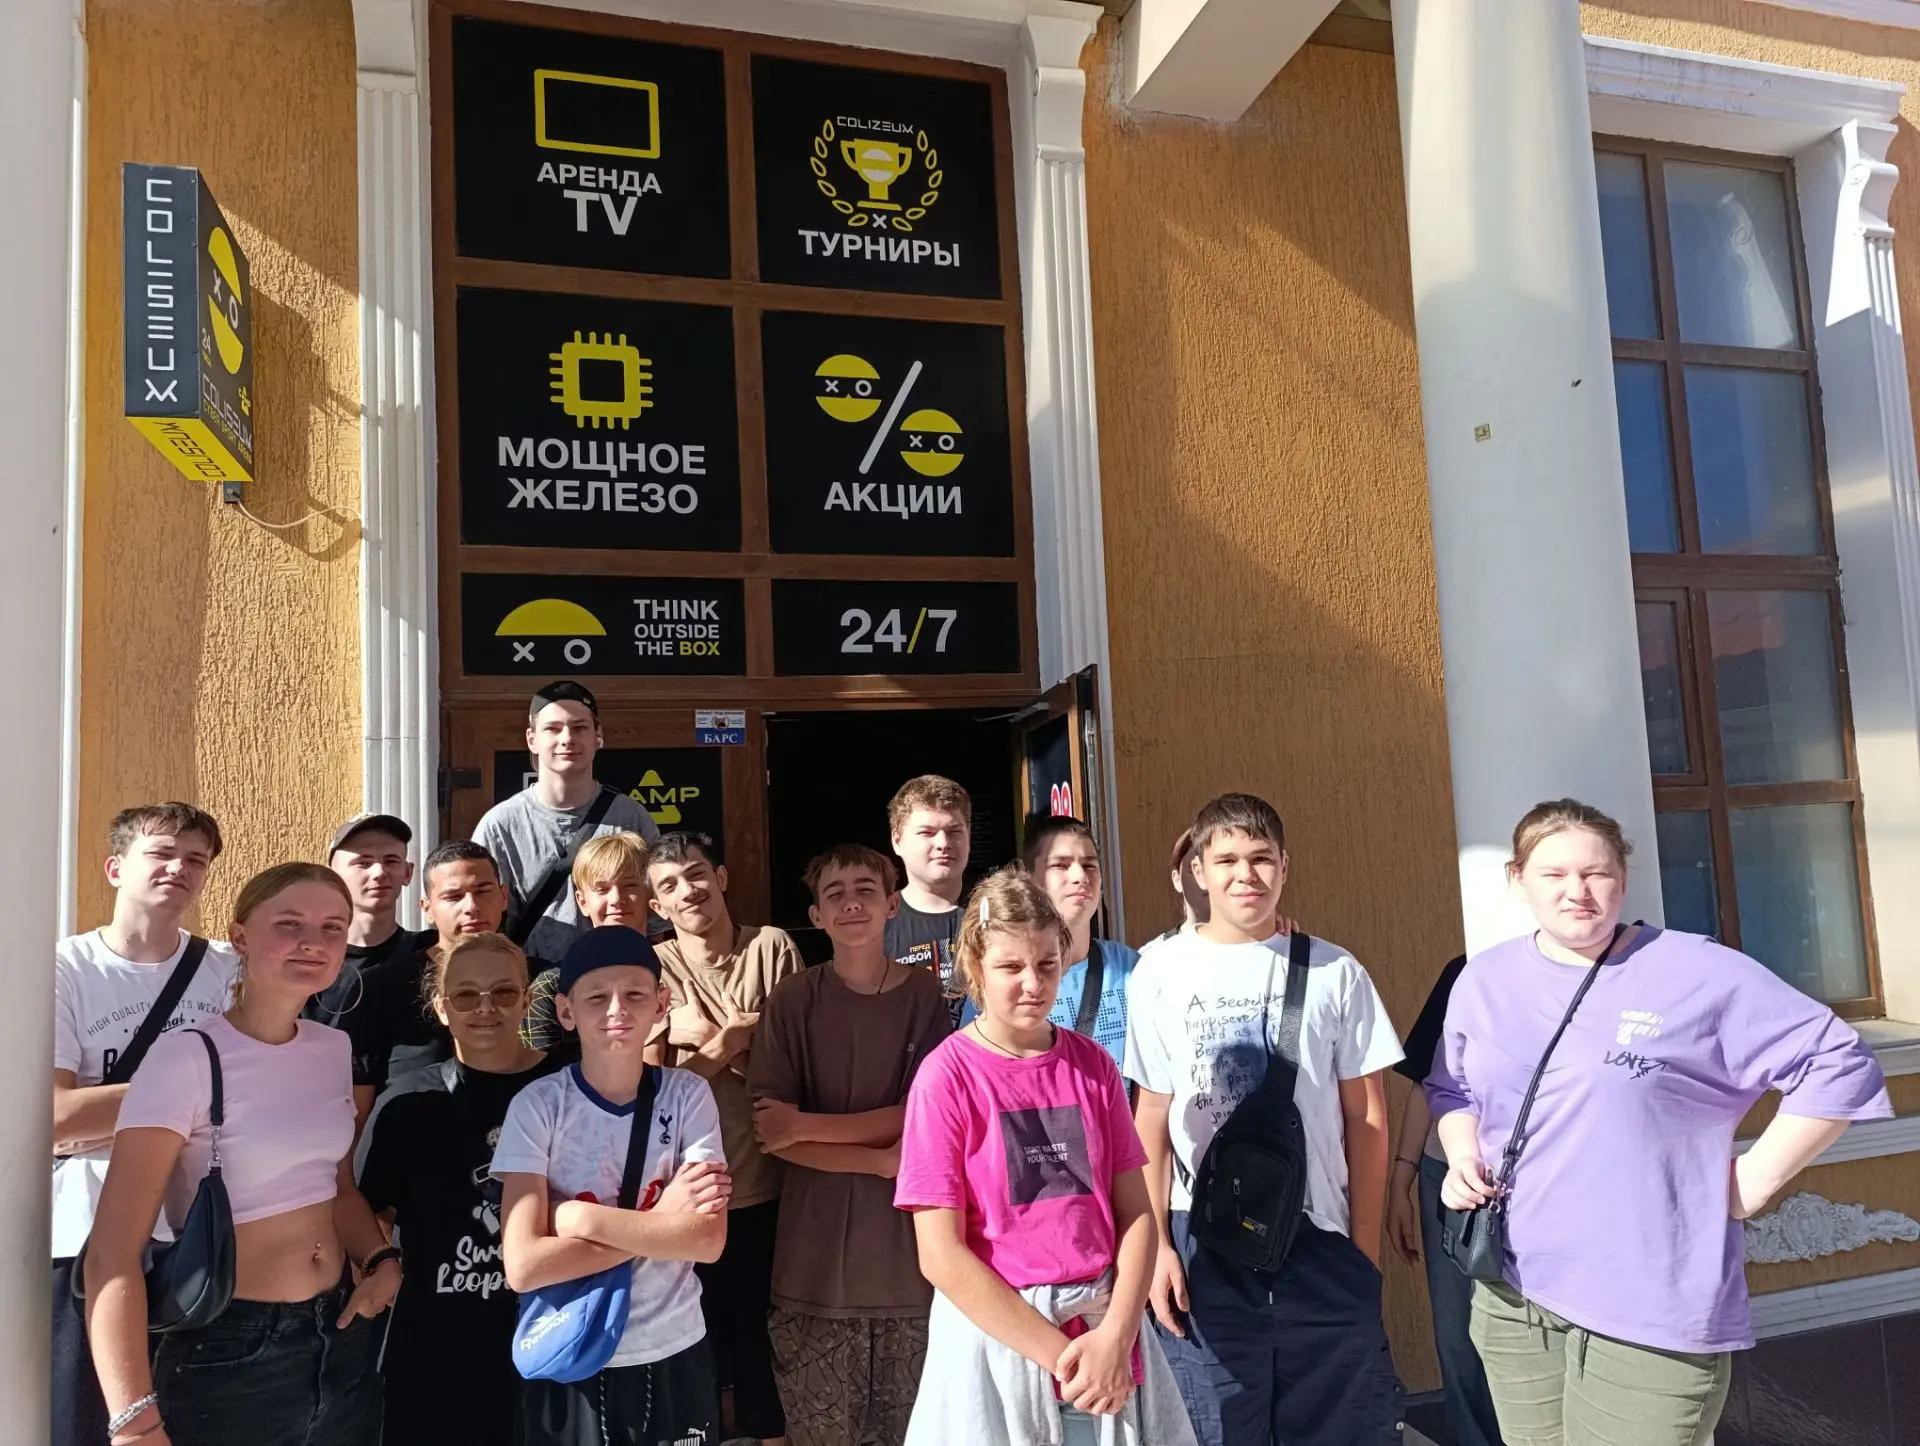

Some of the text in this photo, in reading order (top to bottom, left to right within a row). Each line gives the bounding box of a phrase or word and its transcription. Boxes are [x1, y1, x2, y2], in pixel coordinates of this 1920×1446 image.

[537, 162, 662, 197] АРЕНДА
[563, 189, 638, 236] TV
[798, 229, 960, 267] ТУРНИРЫ
[499, 437, 706, 478] МОЩНОЕ
[507, 477, 698, 514] ЖЕЛЕЗО
[824, 481, 962, 519] АКЦИИ
[634, 599, 719, 620] THINK
[634, 624, 719, 639] OUTSIDE
[840, 607, 957, 654] 24/7
[635, 641, 720, 655] THE BOX
[704, 733, 738, 745] БАРС
[628, 786, 700, 804] AMP
[1187, 994, 1206, 1013] A
[87, 1016, 111, 1037] HIGH
[1195, 1092, 1214, 1110] the
[436, 1262, 511, 1299] Leop
